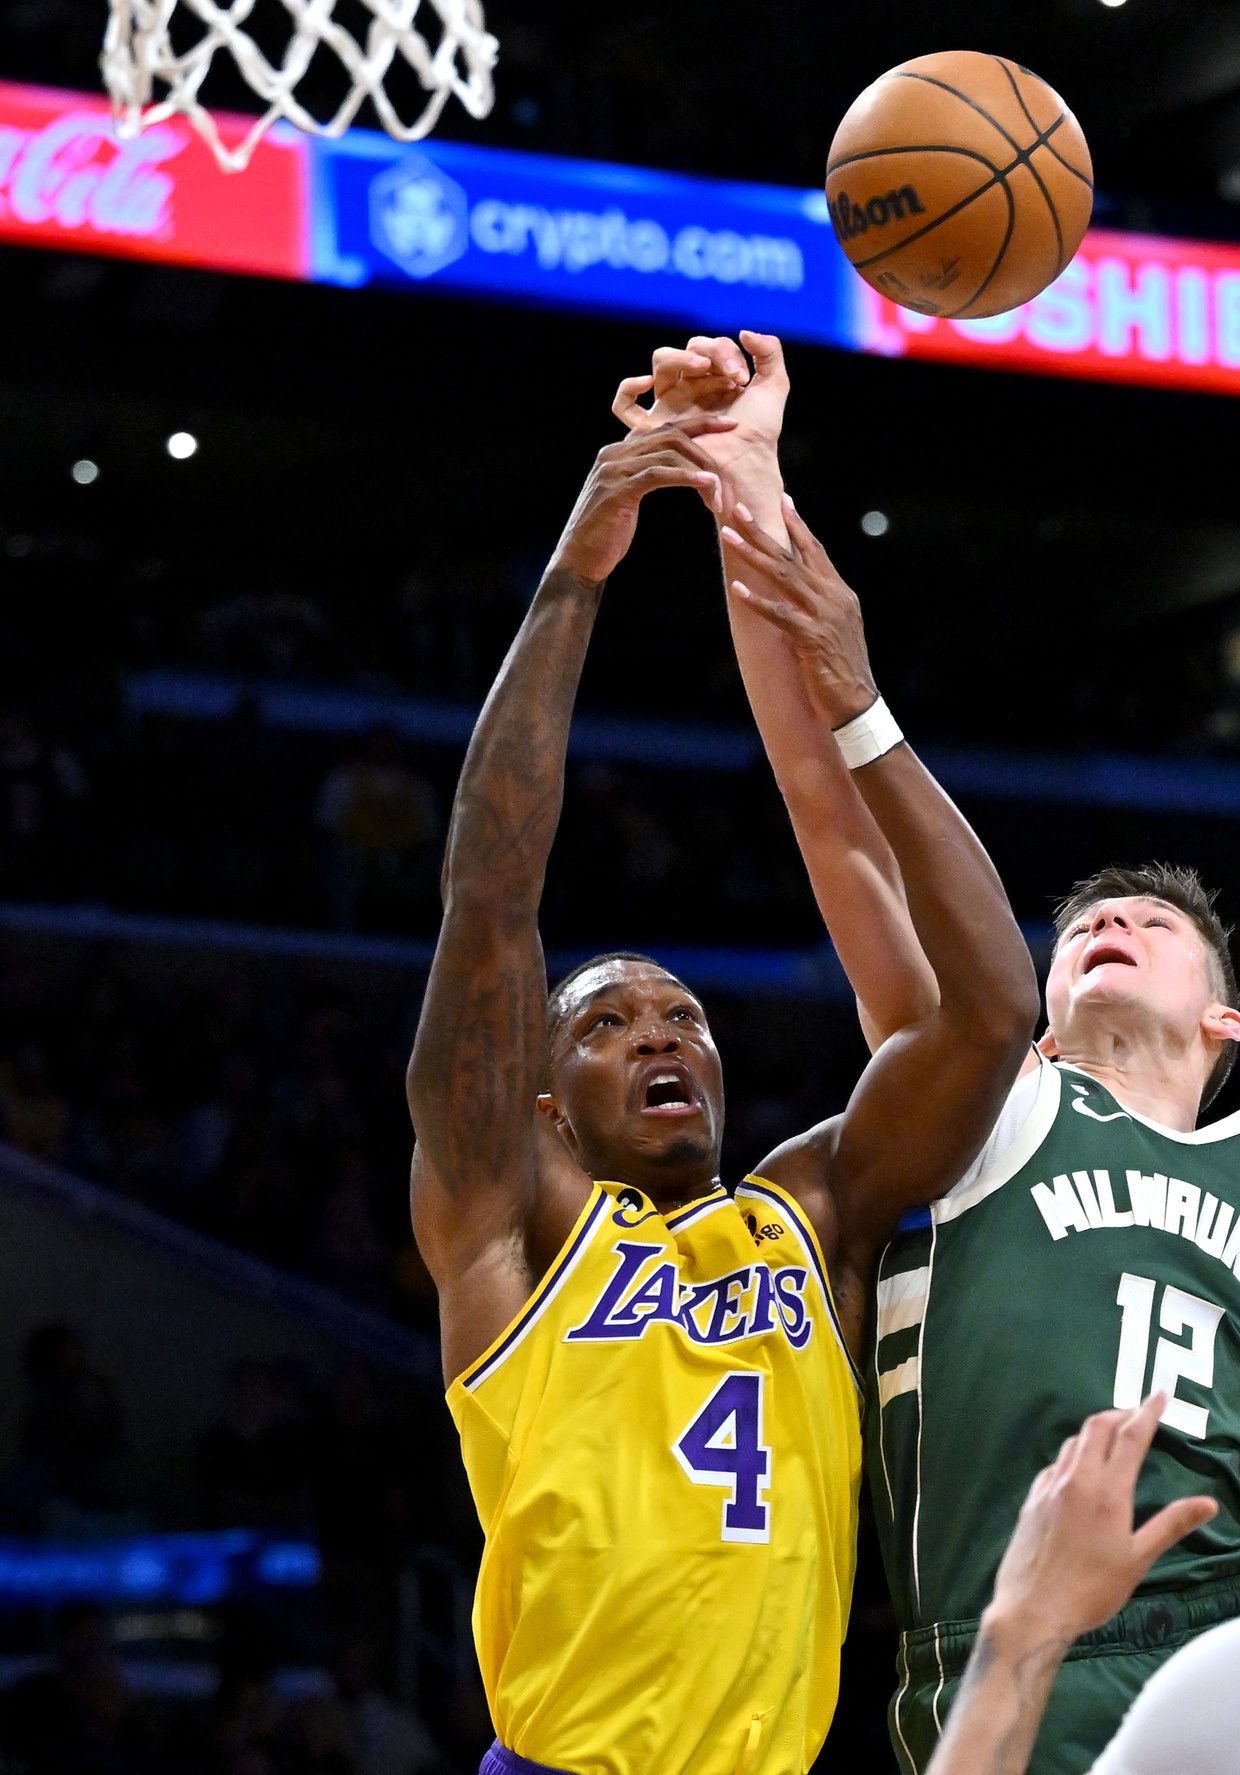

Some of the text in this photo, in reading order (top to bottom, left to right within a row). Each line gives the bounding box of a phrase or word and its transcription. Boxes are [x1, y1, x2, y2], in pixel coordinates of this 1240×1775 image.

[470, 199, 804, 292] crypto.com
[1113, 1272, 1226, 1440] 12
[671, 1371, 773, 1544] 4
